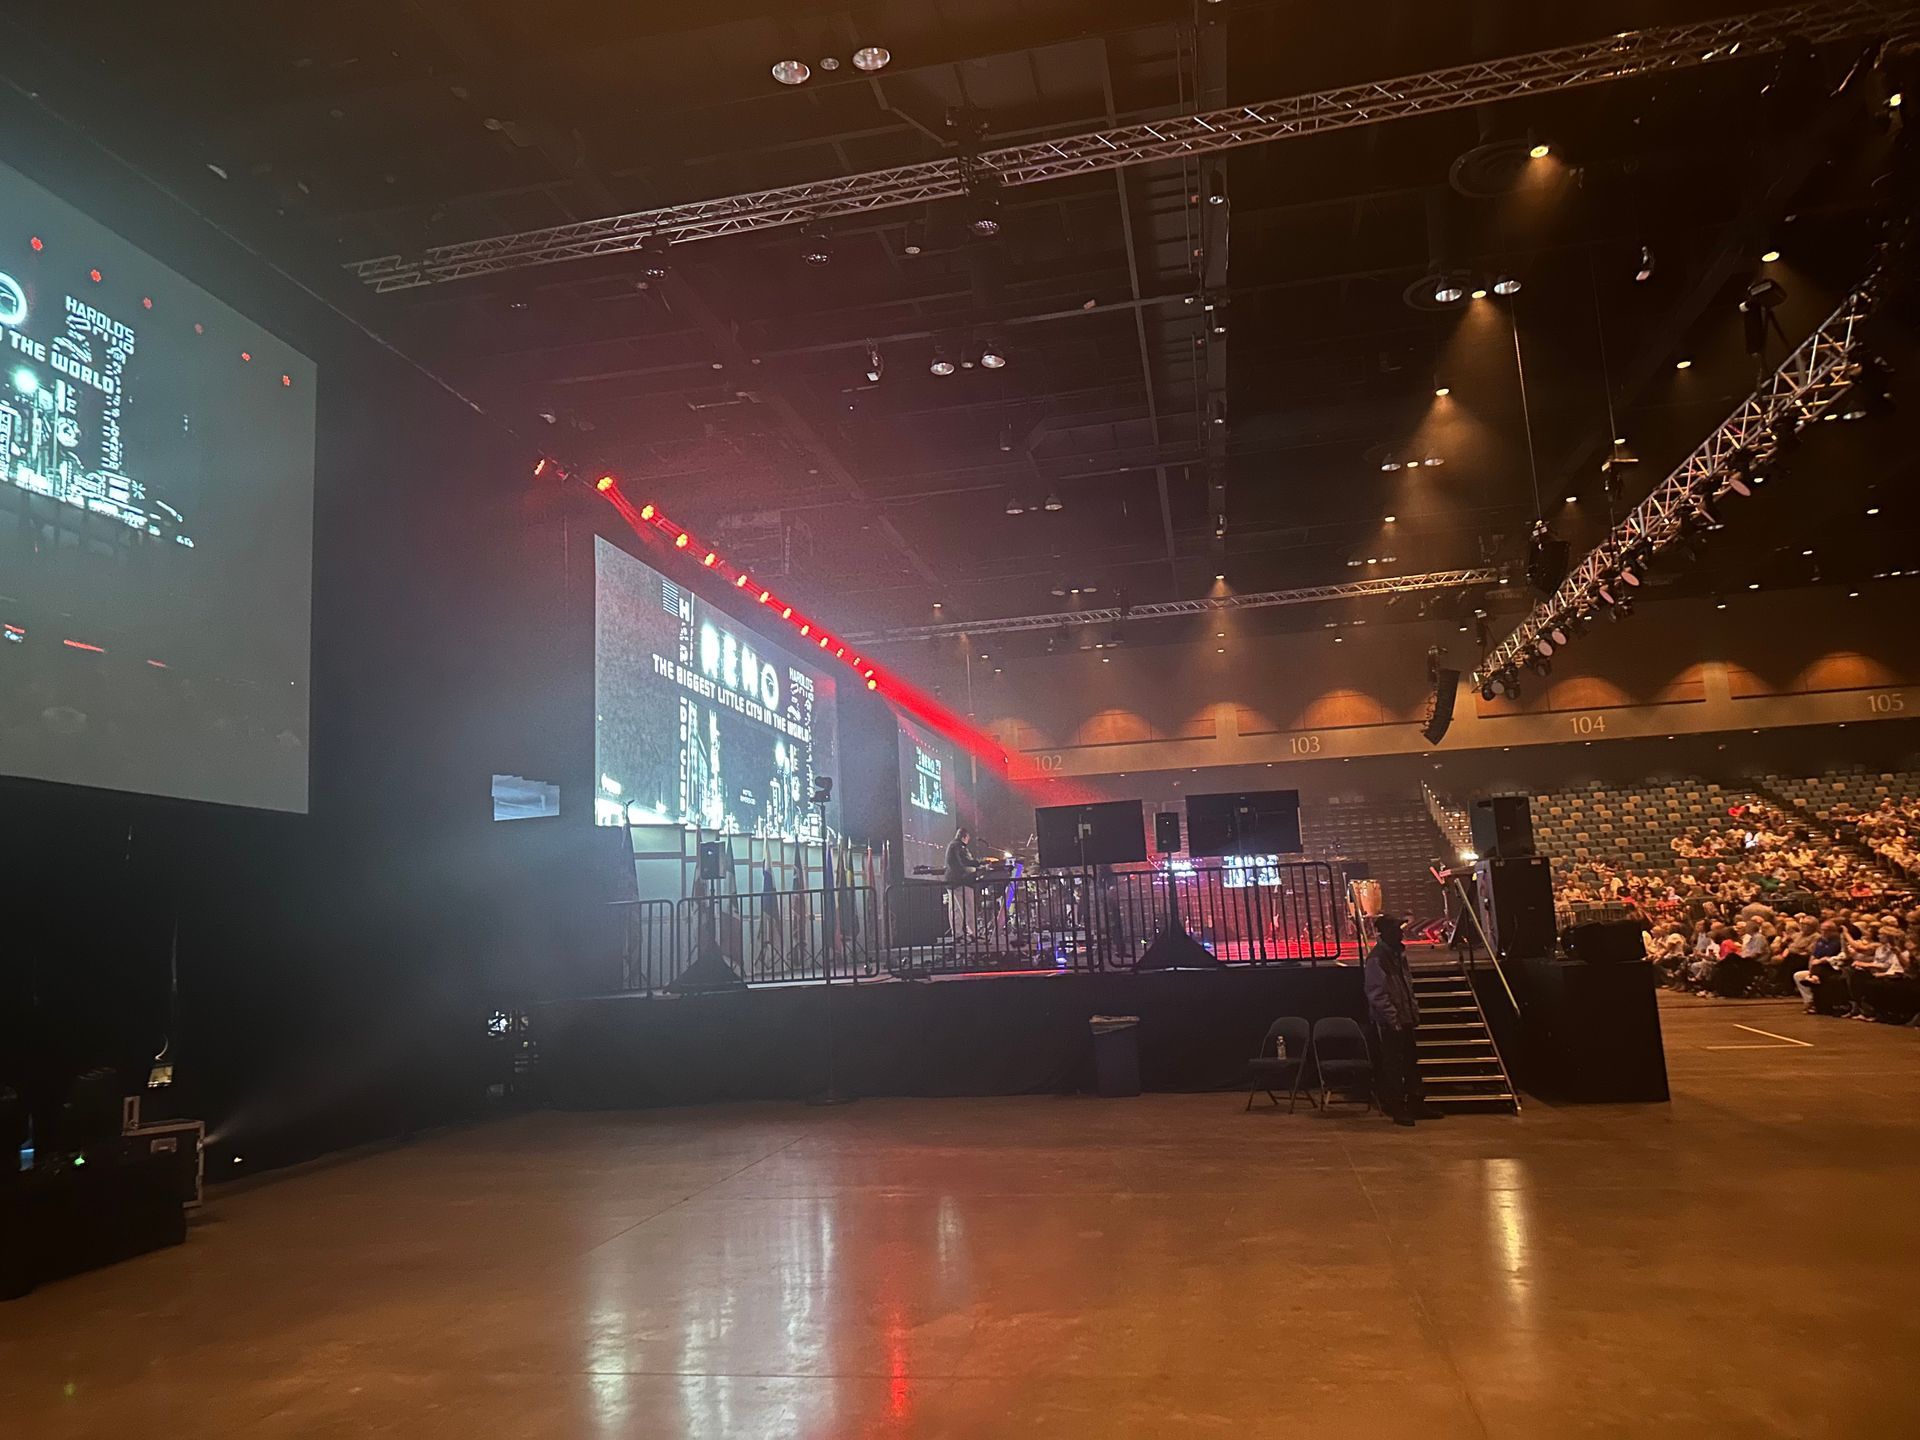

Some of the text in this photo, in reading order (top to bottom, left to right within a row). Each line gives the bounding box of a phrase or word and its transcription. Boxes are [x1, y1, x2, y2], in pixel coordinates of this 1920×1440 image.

[9, 329, 114, 394] THE WORLD
[700, 620, 779, 711] RENO
[652, 653, 810, 743] THE BIGGEST LITTLE CITY IN THE WORLD
[1867, 694, 1904, 713] 105
[1569, 716, 1606, 734] 104
[1289, 736, 1321, 754] 103
[1033, 755, 1063, 771] 102
